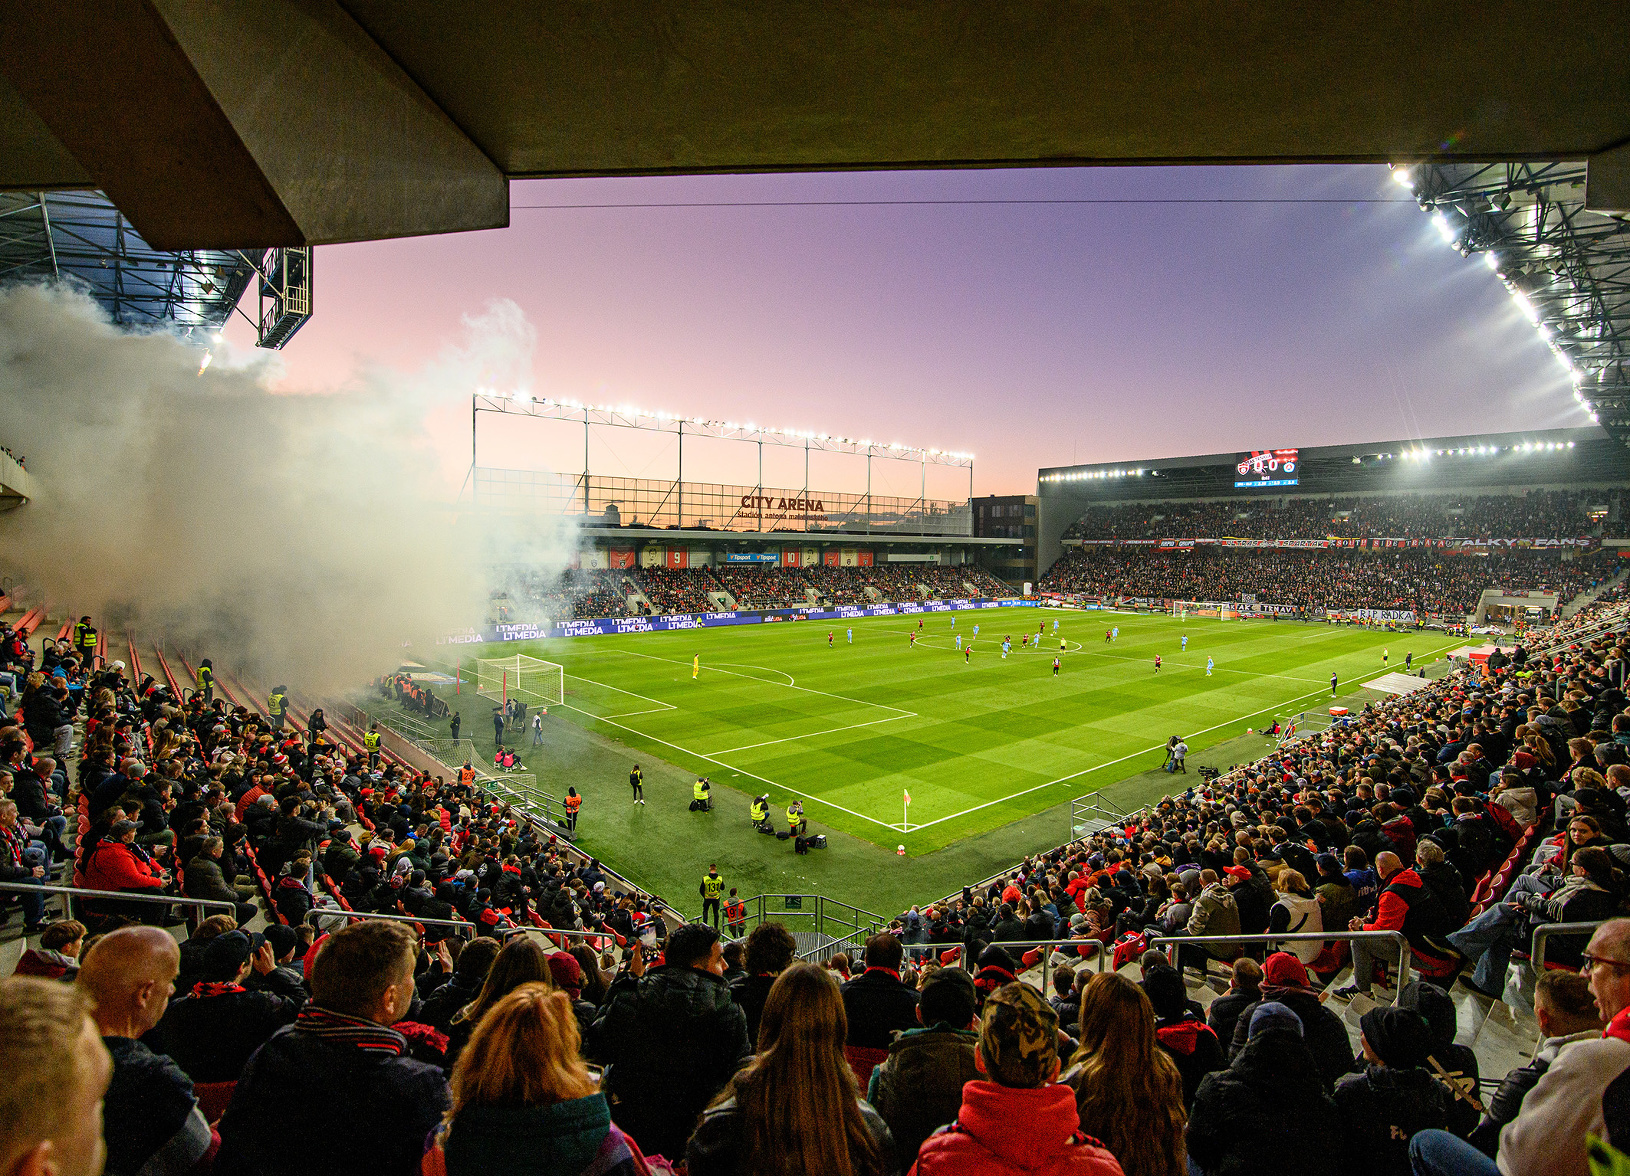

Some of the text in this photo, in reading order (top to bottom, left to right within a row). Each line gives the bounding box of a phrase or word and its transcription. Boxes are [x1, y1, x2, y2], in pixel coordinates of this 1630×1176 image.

[741, 495, 824, 512] CITY ARENA
[1336, 539, 1445, 547] SOUTH SIDE TRNAVA
[674, 552, 680, 563] 9
[787, 552, 795, 562] 10
[1381, 610, 1412, 620] RADKA
[503, 630, 546, 640] LTMEDIA
[564, 626, 603, 636] LTMEDIA
[707, 883, 719, 893] 131
